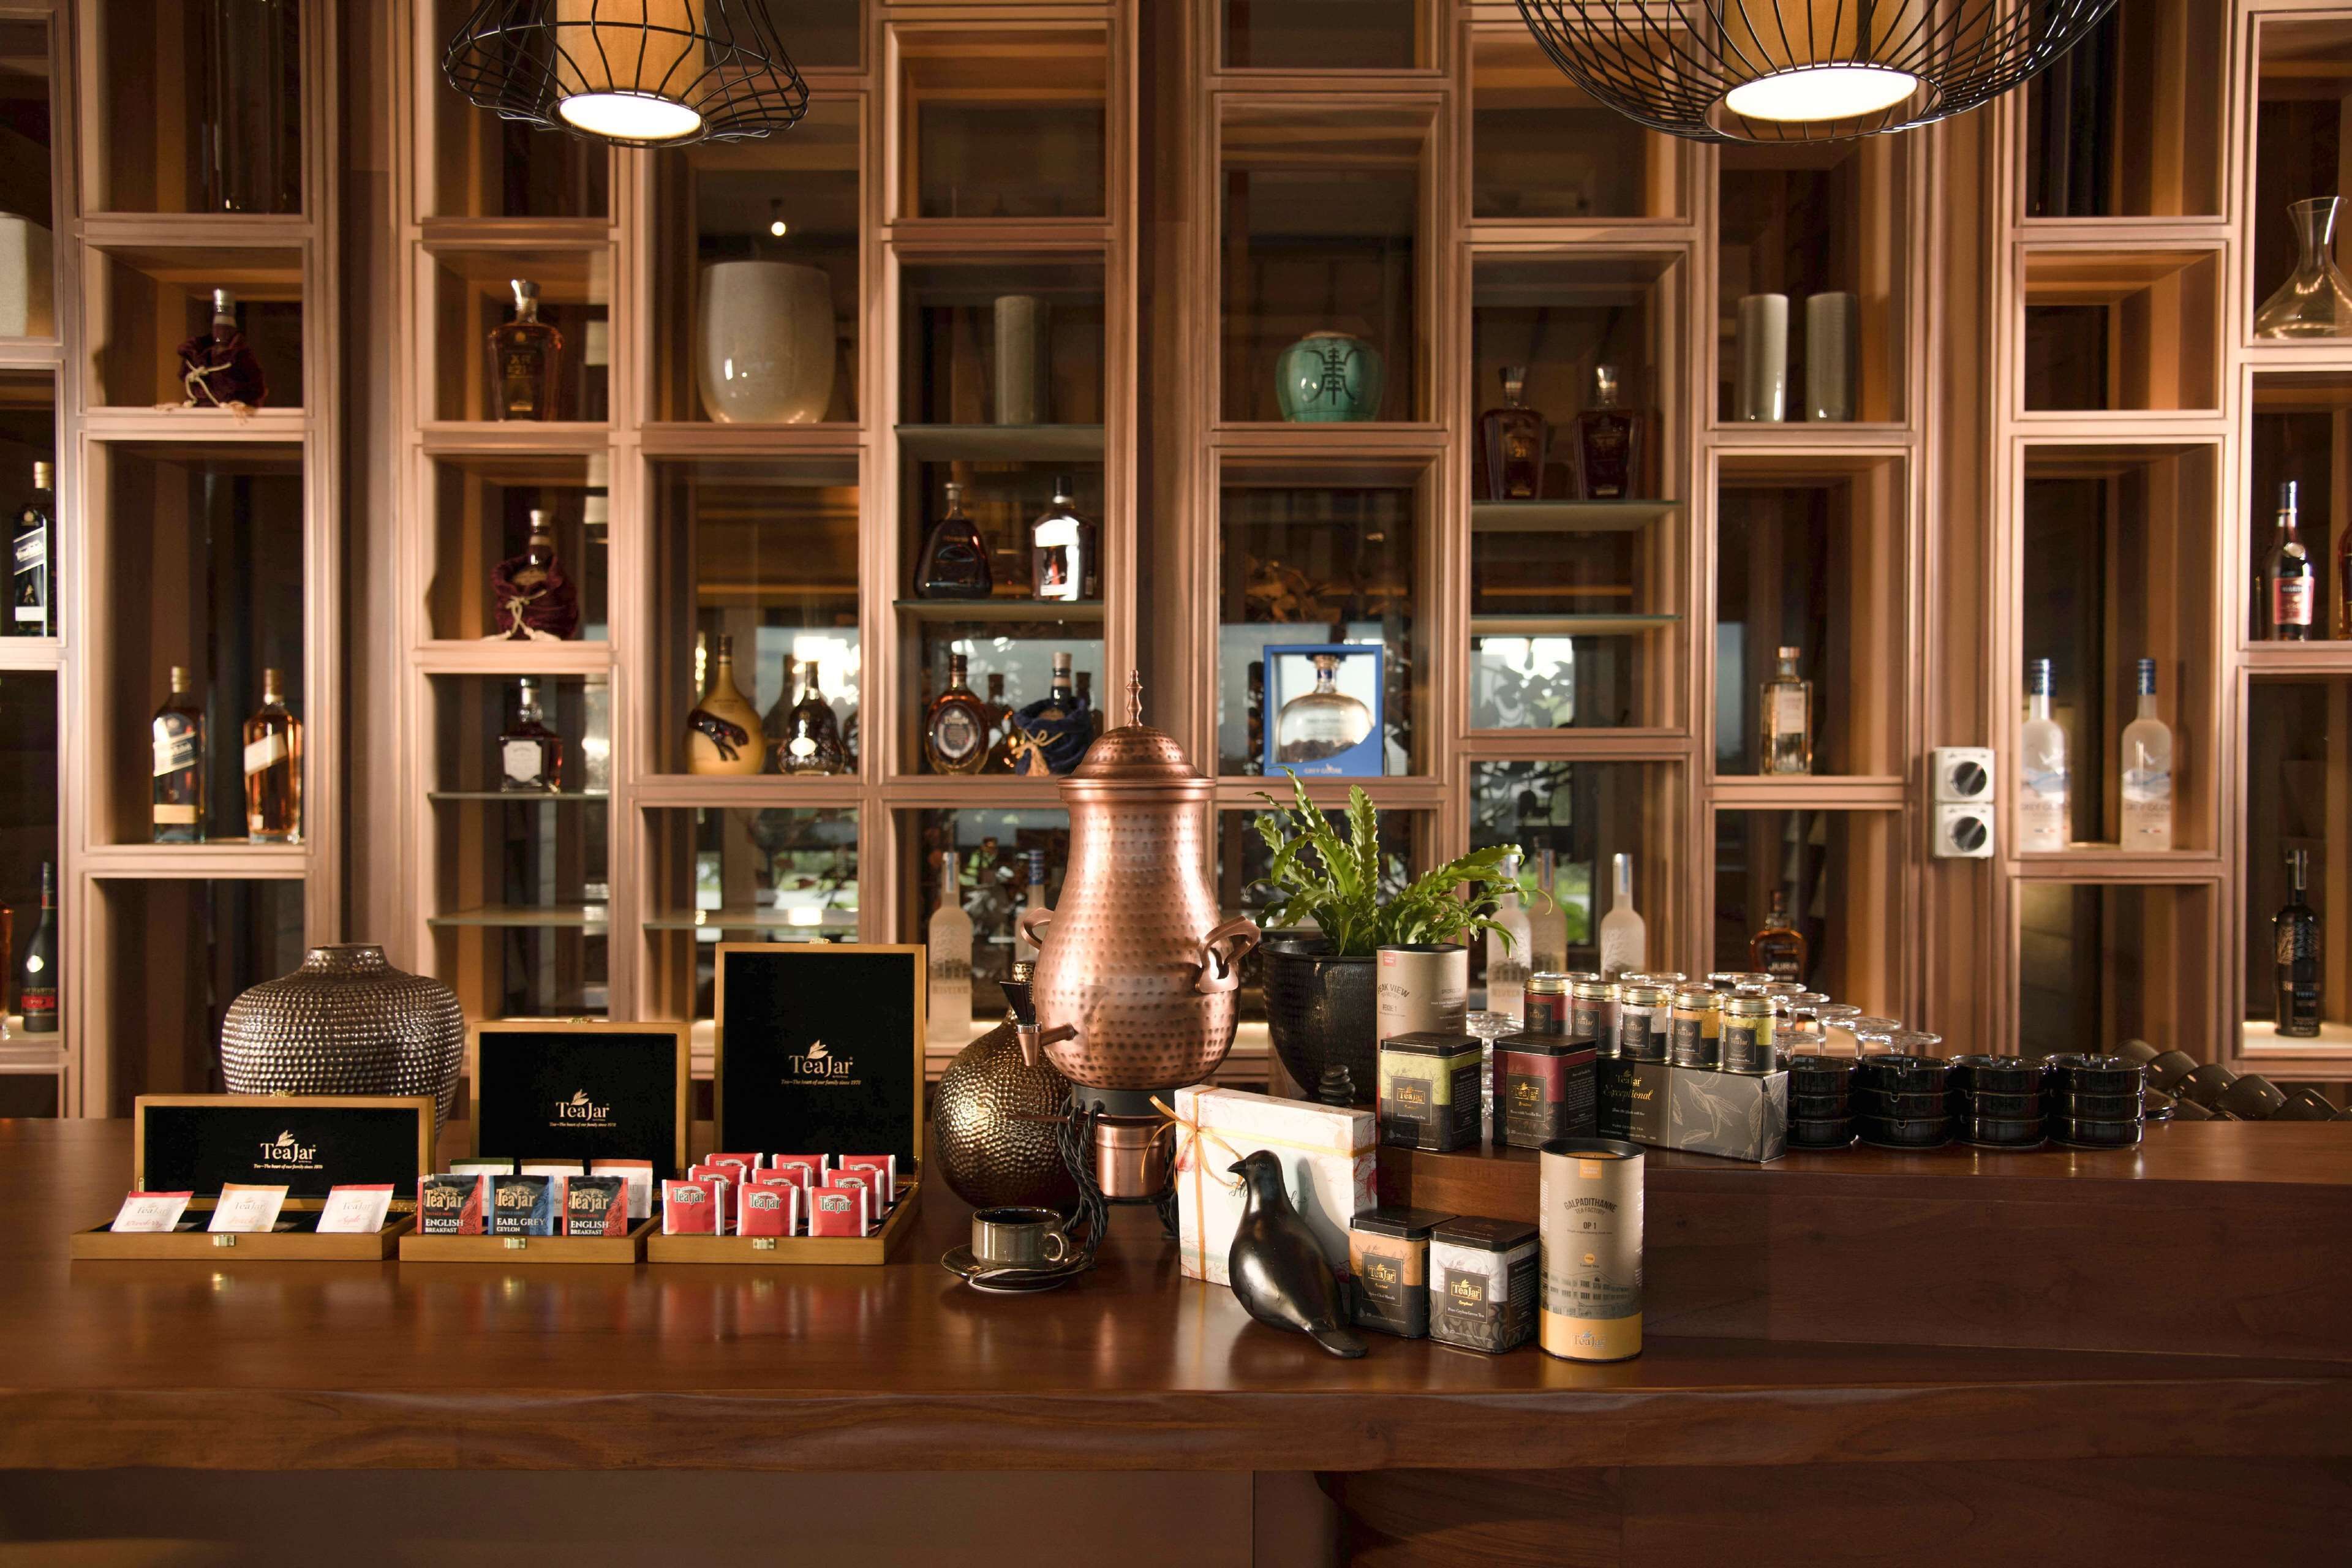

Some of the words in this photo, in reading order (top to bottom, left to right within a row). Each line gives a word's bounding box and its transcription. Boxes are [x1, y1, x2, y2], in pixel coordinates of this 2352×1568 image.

[1389, 984, 1410, 998] VIEW
[1564, 1197, 1617, 1213] GALPADITHANNE
[1585, 1207, 1605, 1216] FACTORY
